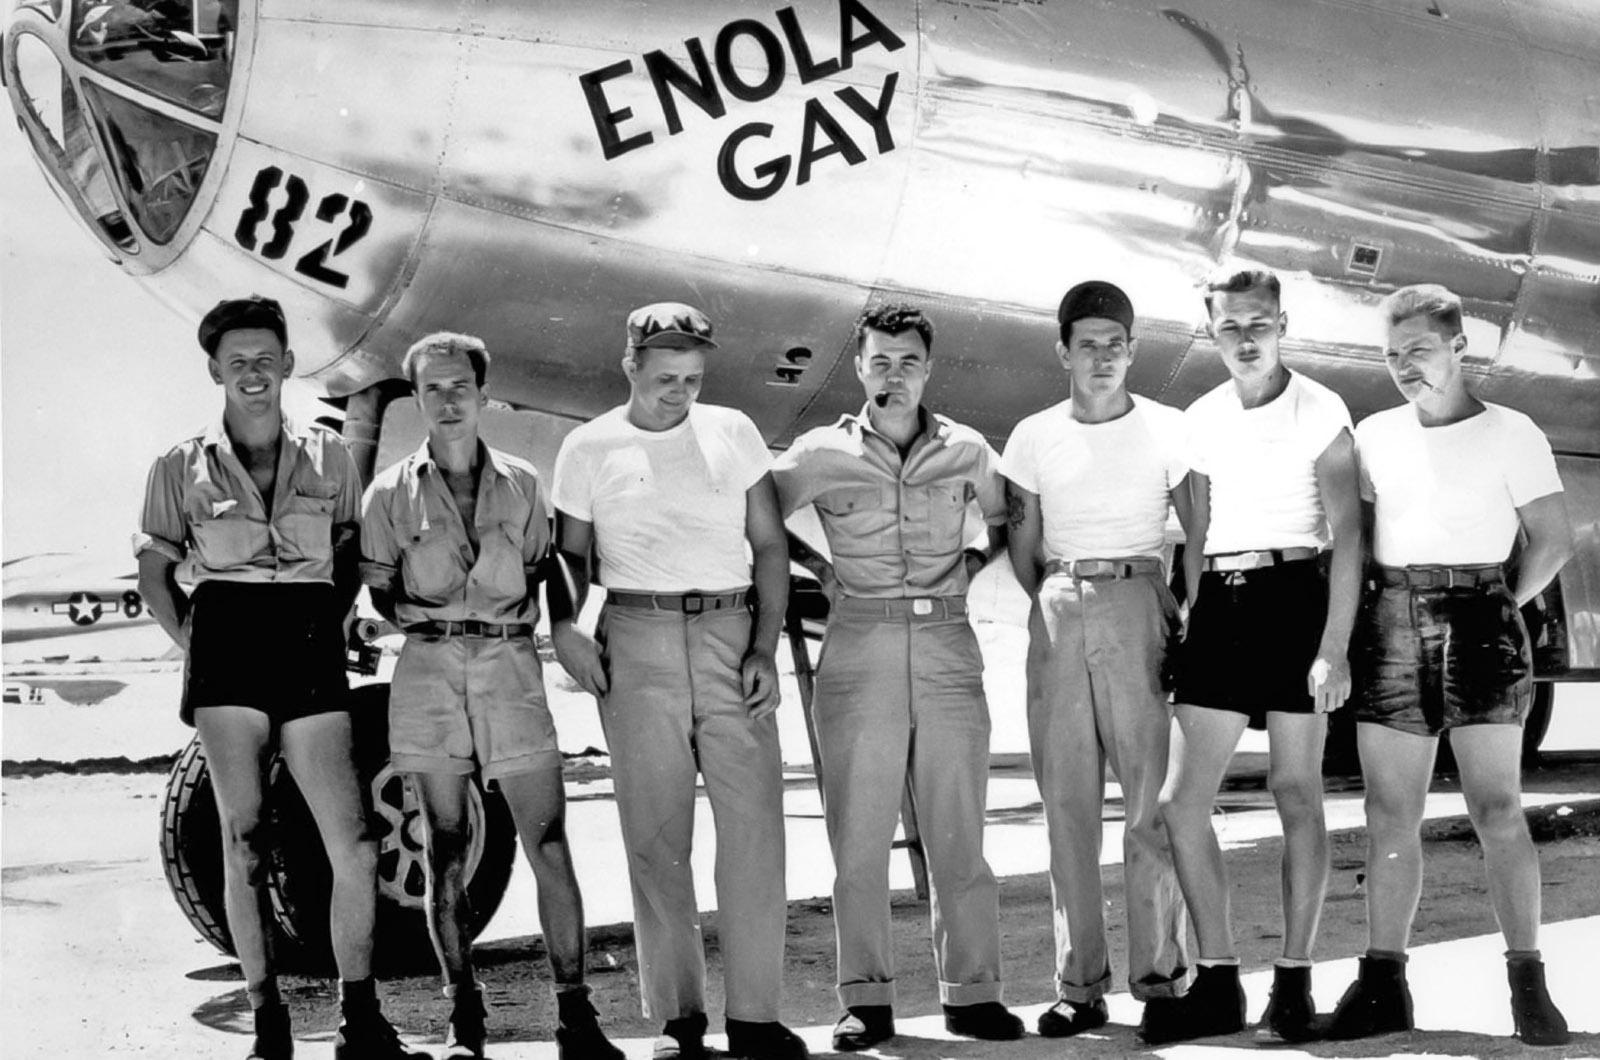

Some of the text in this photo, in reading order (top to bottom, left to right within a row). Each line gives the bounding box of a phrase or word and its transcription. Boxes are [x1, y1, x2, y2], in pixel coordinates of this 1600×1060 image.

[579, 0, 906, 161] ENOLA
[717, 72, 899, 201] GAY
[235, 165, 373, 289] 82
[122, 589, 155, 619] 8
